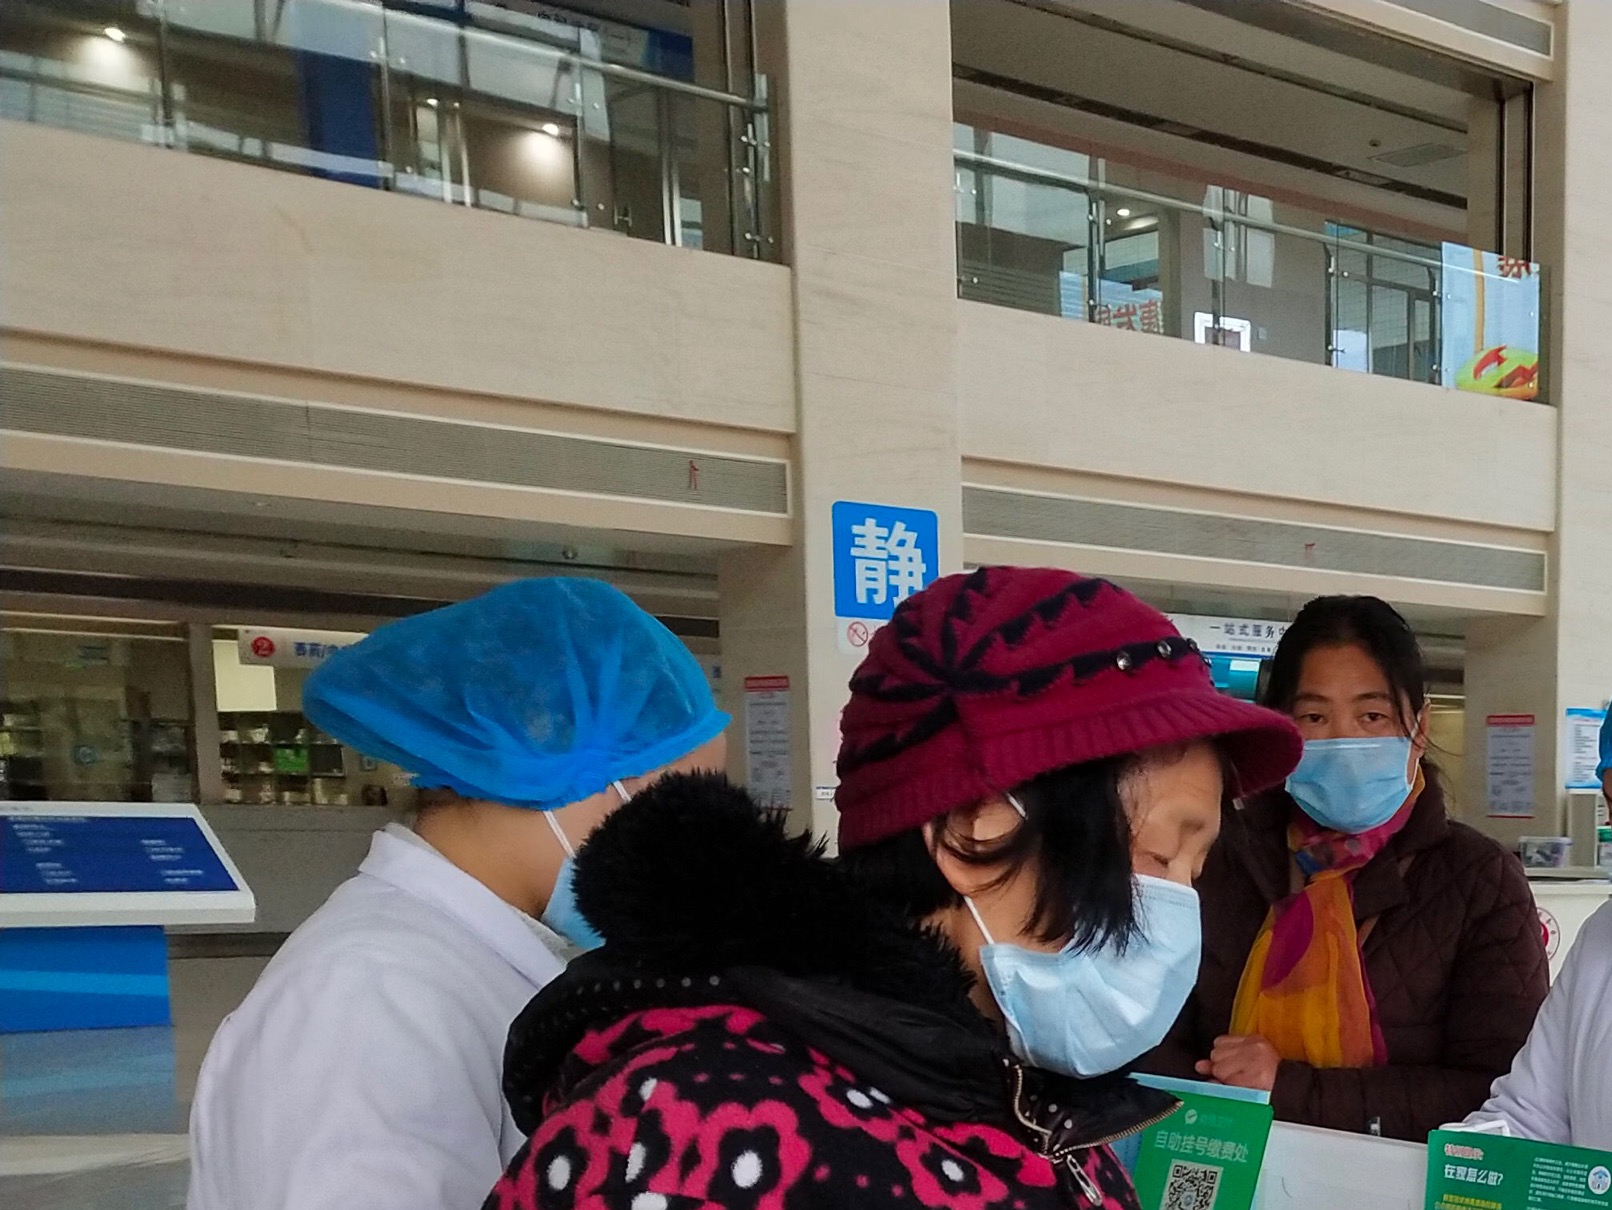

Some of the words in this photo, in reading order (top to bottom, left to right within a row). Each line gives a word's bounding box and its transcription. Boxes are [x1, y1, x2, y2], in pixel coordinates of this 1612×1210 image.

[849, 516, 927, 607] 静
[1154, 1129, 1249, 1163] 自助挂号缴费处
